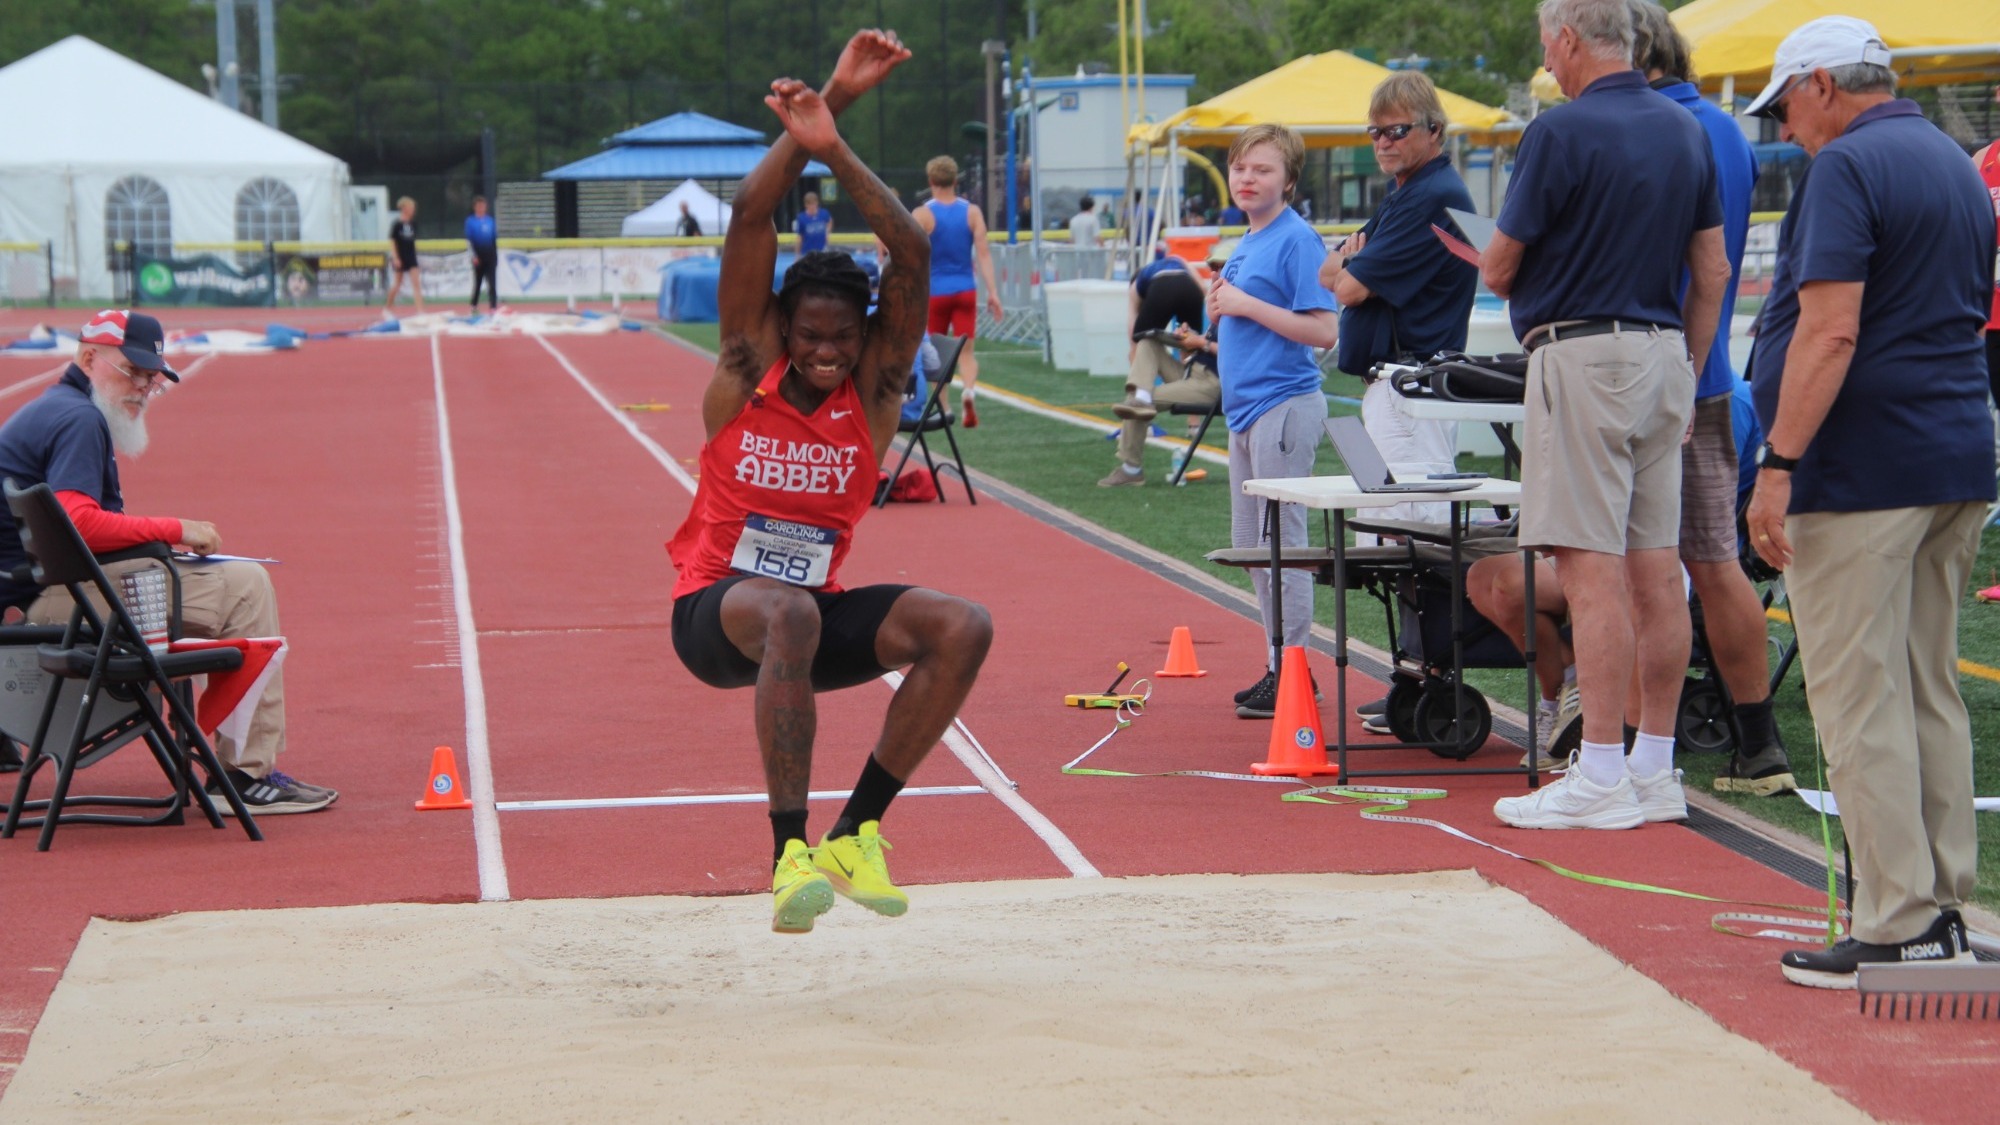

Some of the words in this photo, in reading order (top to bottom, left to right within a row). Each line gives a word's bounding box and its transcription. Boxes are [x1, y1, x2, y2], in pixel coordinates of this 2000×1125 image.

[739, 430, 858, 465] BELMONT
[735, 454, 856, 494] ABBEY
[764, 521, 825, 541] CAROLINAS
[752, 538, 792, 553] BELMONT
[796, 548, 821, 559] ABBEY
[754, 546, 811, 582] 158
[1900, 941, 1944, 960] HOKA
